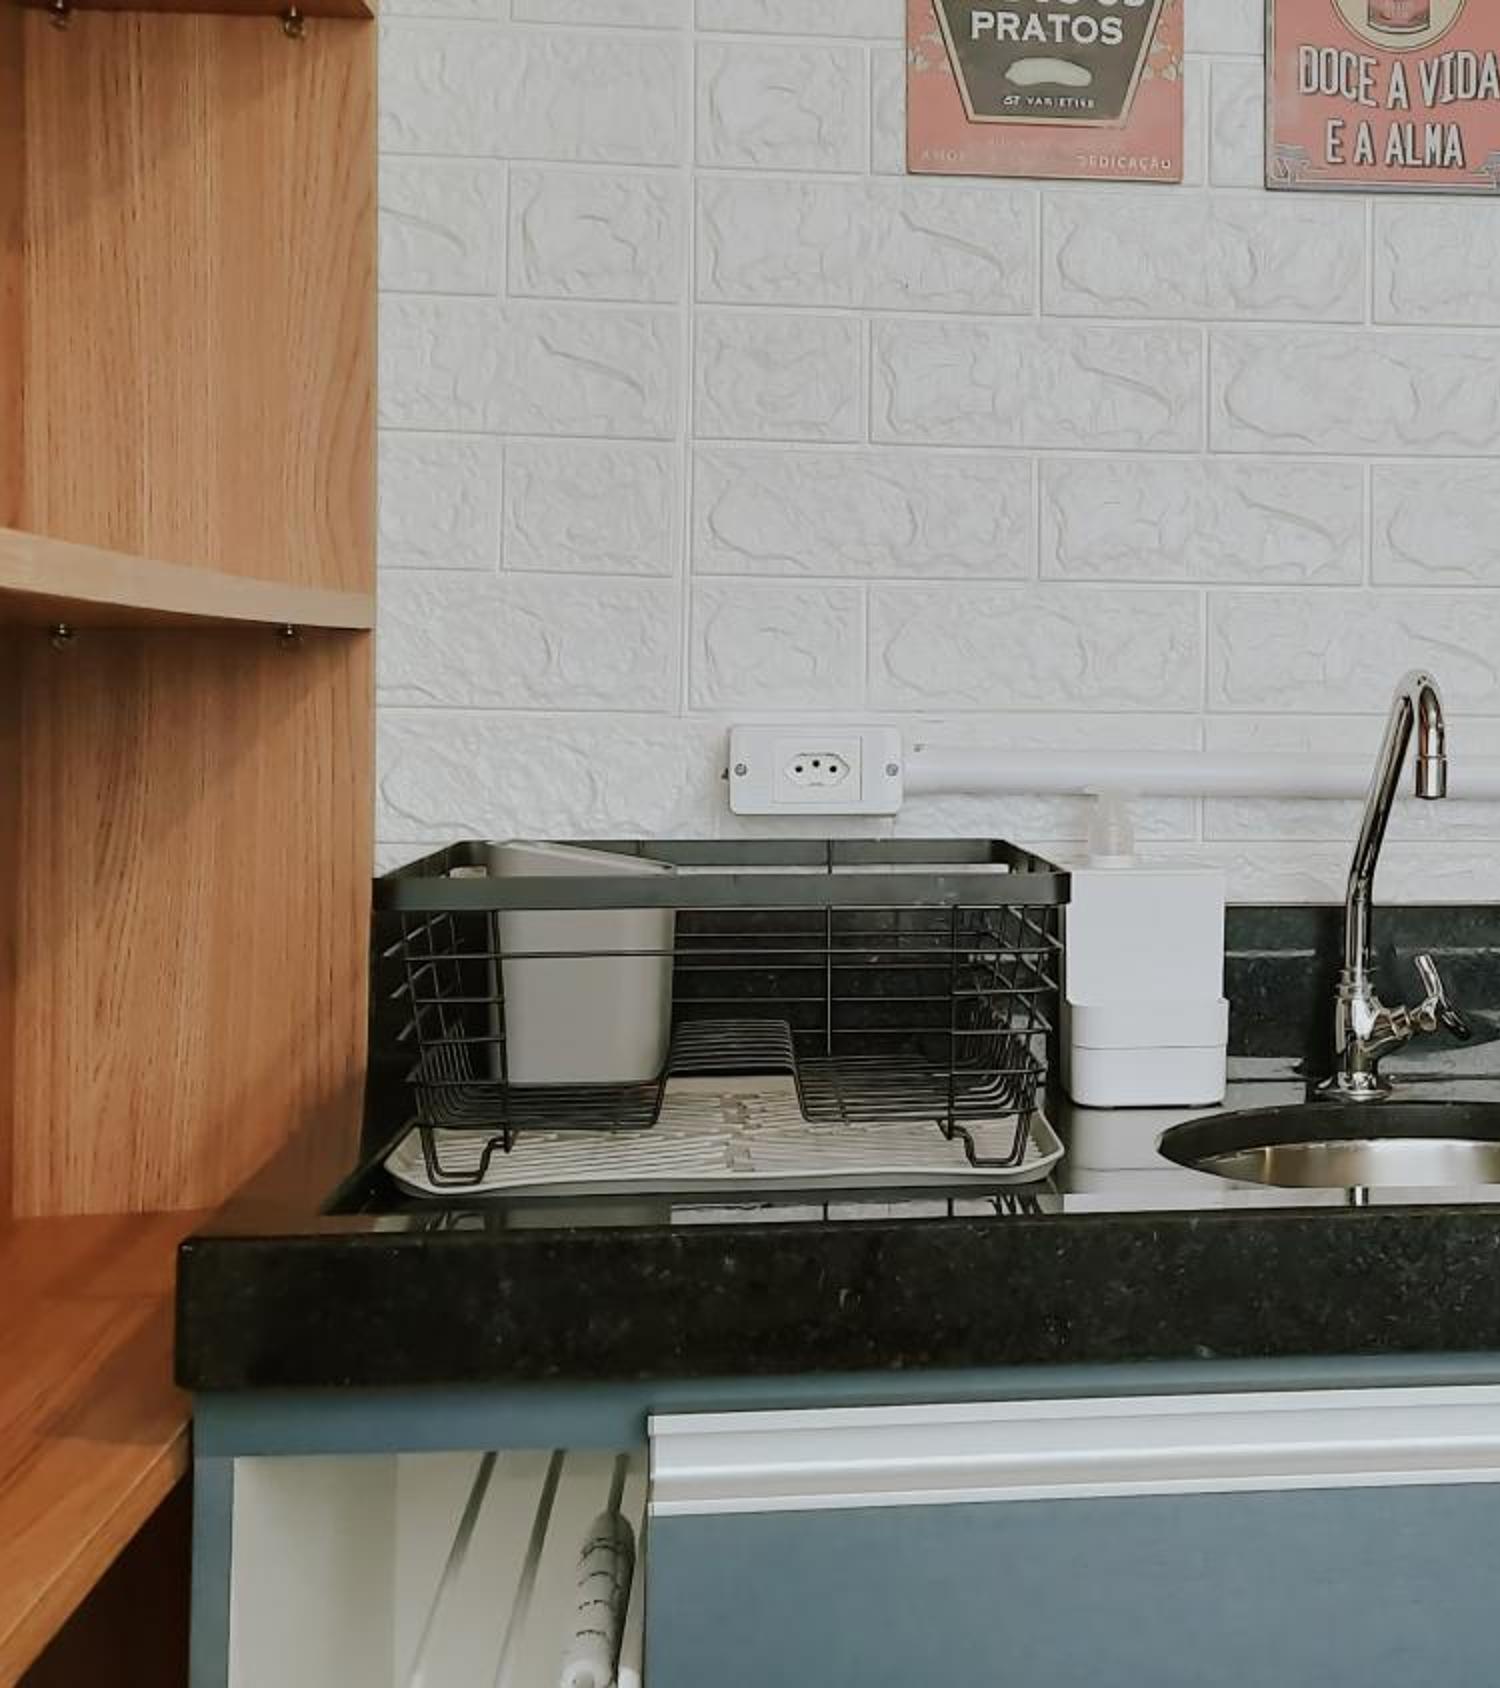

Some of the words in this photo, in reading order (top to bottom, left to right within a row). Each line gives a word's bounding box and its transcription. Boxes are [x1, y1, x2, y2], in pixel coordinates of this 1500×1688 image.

[971, 10, 1124, 46] PRATOS
[1300, 45, 1379, 108] DOCE
[1387, 59, 1411, 110] A
[1326, 118, 1345, 164] E
[1354, 120, 1376, 166] A
[1385, 122, 1466, 168] ALMA
